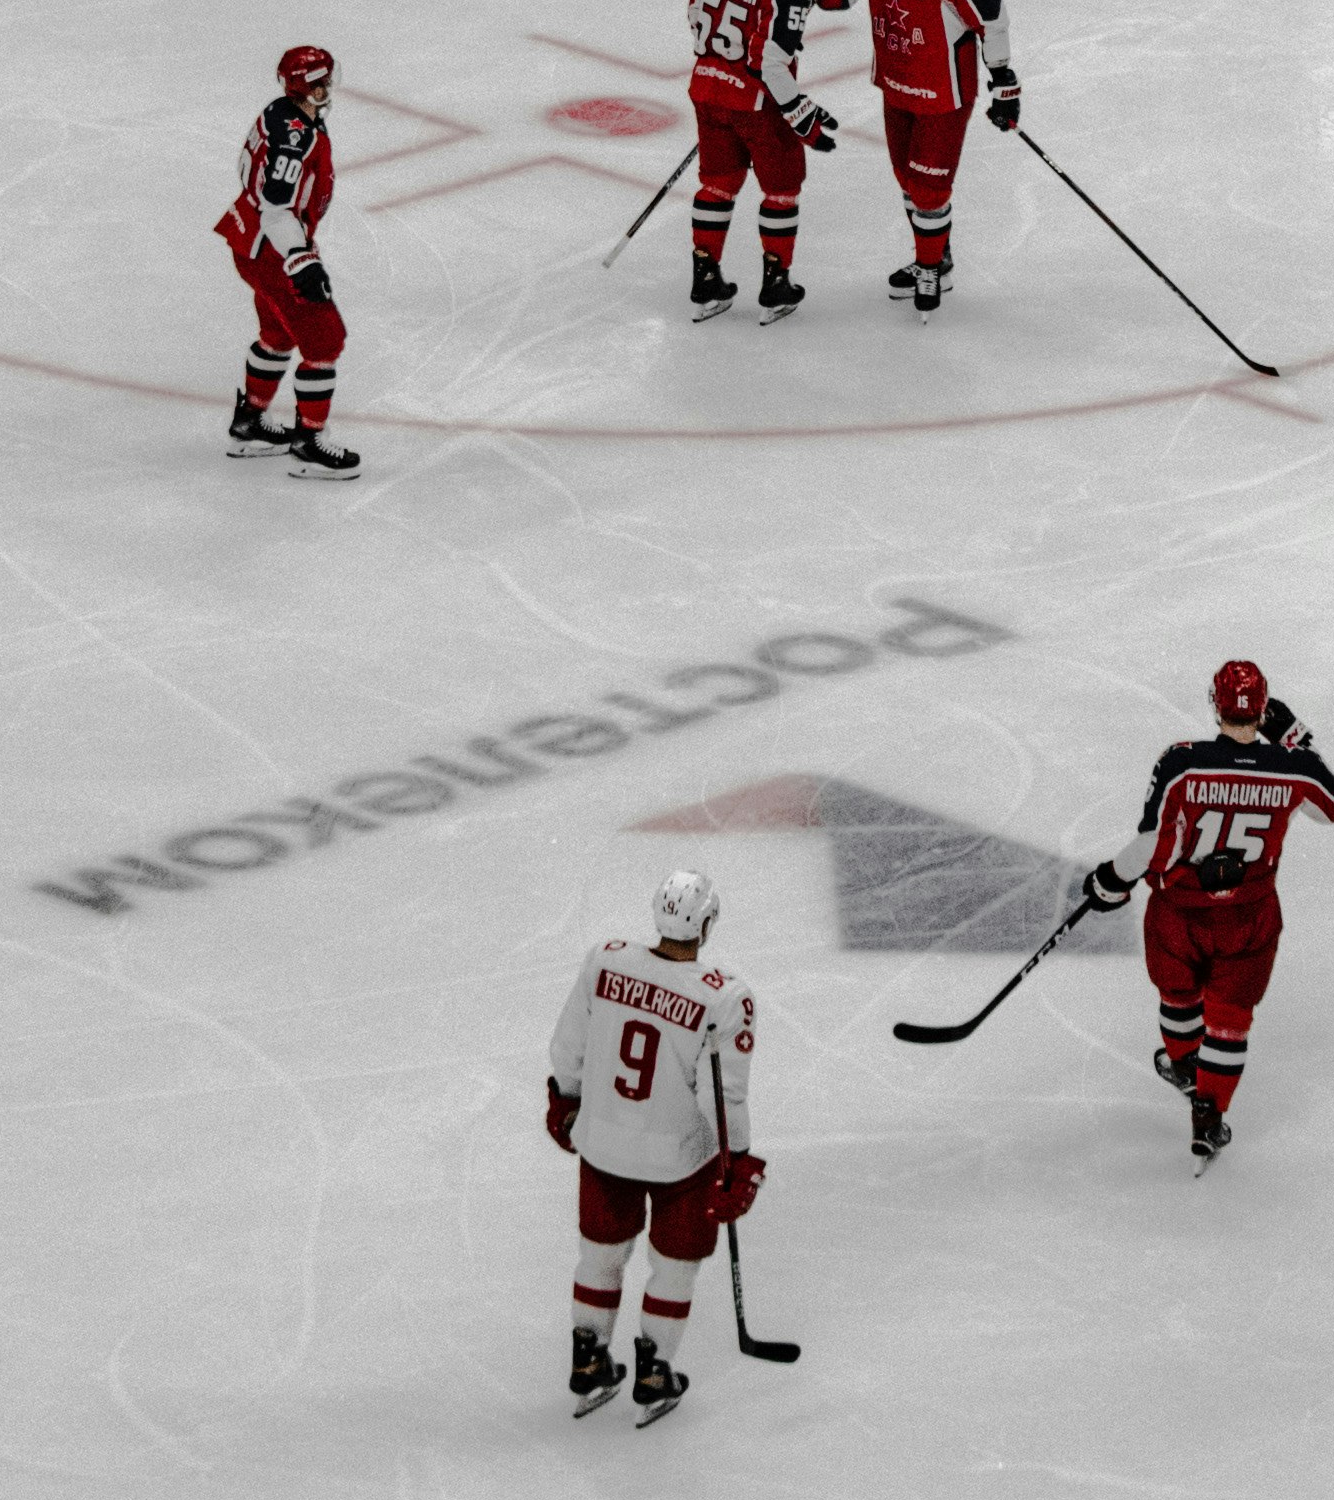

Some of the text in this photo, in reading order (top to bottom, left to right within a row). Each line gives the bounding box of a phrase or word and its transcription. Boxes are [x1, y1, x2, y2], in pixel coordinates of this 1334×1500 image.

[271, 154, 302, 184] 90
[1236, 695, 1249, 709] 15
[30, 597, 1017, 916] Ростелеком
[1185, 779, 1293, 807] KARNAUKHOV
[1188, 809, 1272, 863] 15
[601, 970, 702, 1030] TSYPLAKOV
[614, 1019, 662, 1102] 9
